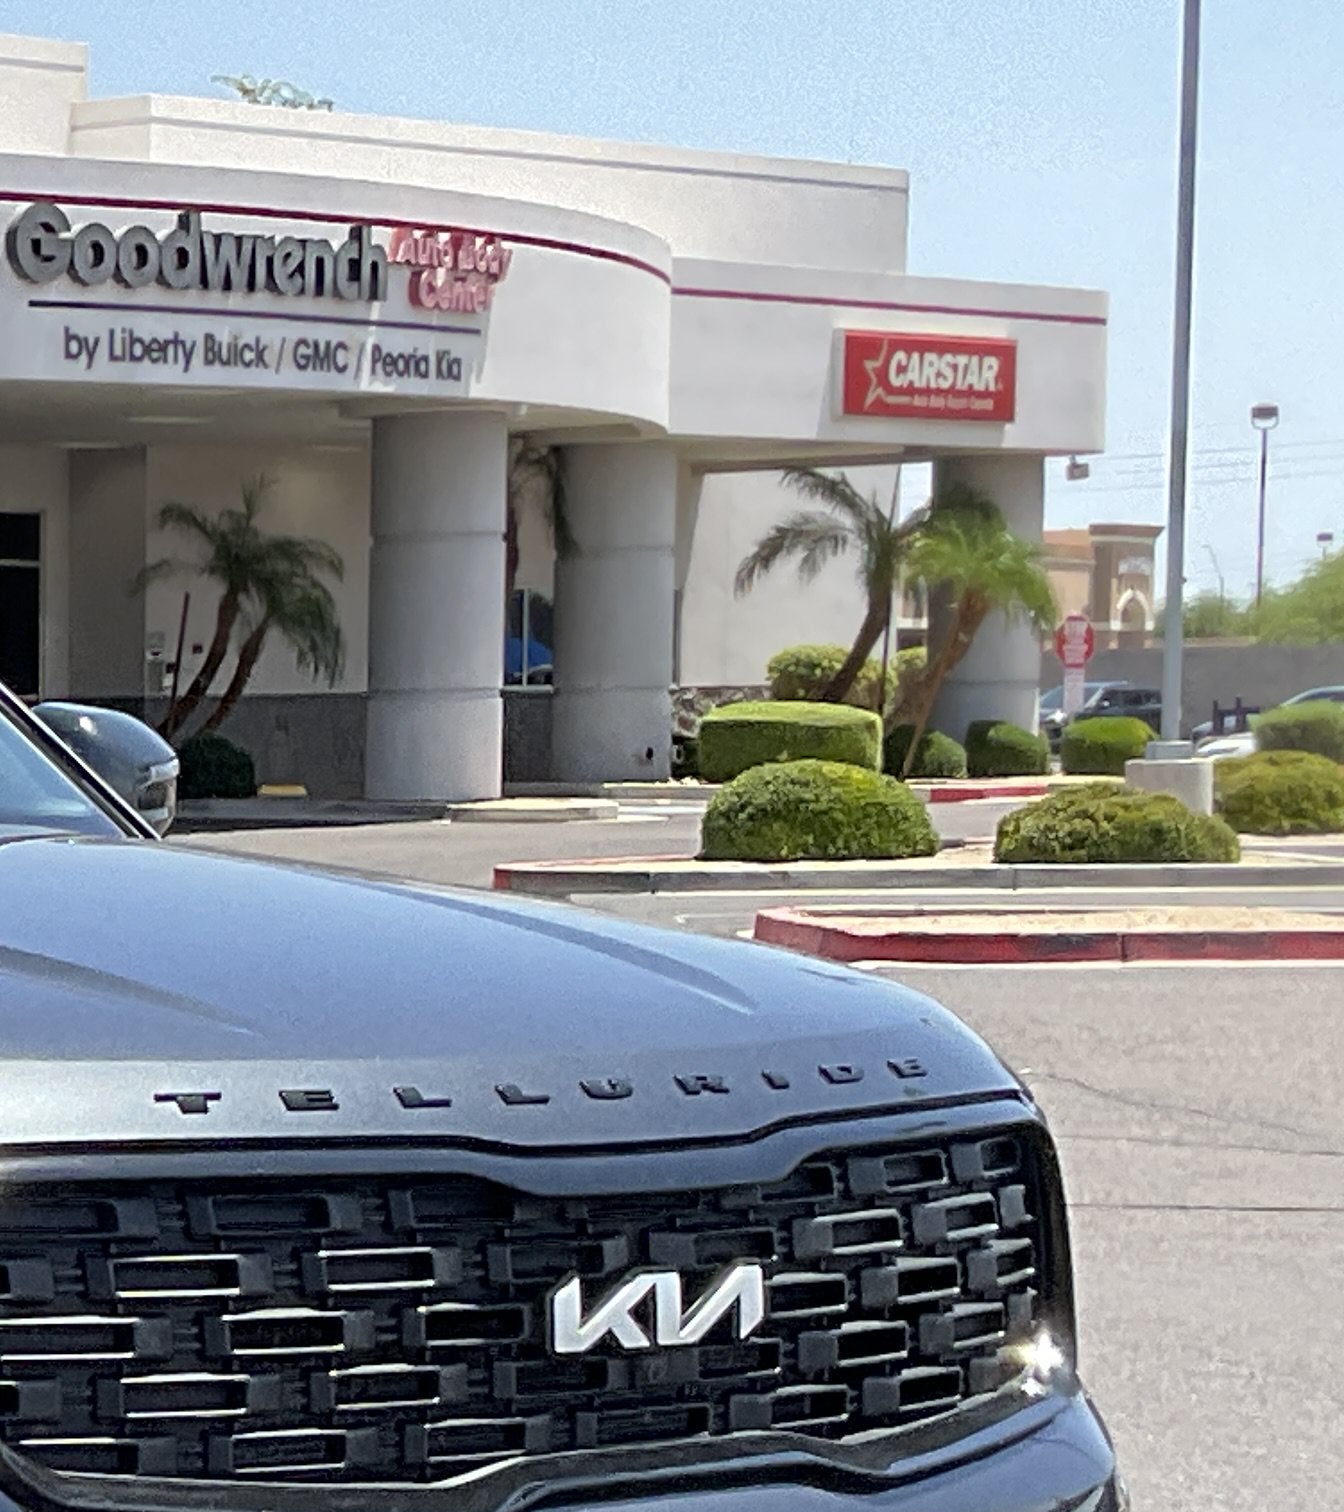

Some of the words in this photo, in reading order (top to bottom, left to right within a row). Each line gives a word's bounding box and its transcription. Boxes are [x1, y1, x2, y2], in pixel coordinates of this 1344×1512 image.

[9, 202, 388, 302] Goodwrench
[64, 327, 100, 370] by
[107, 328, 196, 373] Liberty
[203, 333, 269, 370] Buick
[292, 338, 350, 374] GMC
[370, 343, 430, 381] Peoria
[435, 348, 463, 382] Kia
[888, 350, 1000, 392] CARSTAR
[153, 1057, 929, 1115] TELLURIDE
[551, 1260, 765, 1356] KIA
